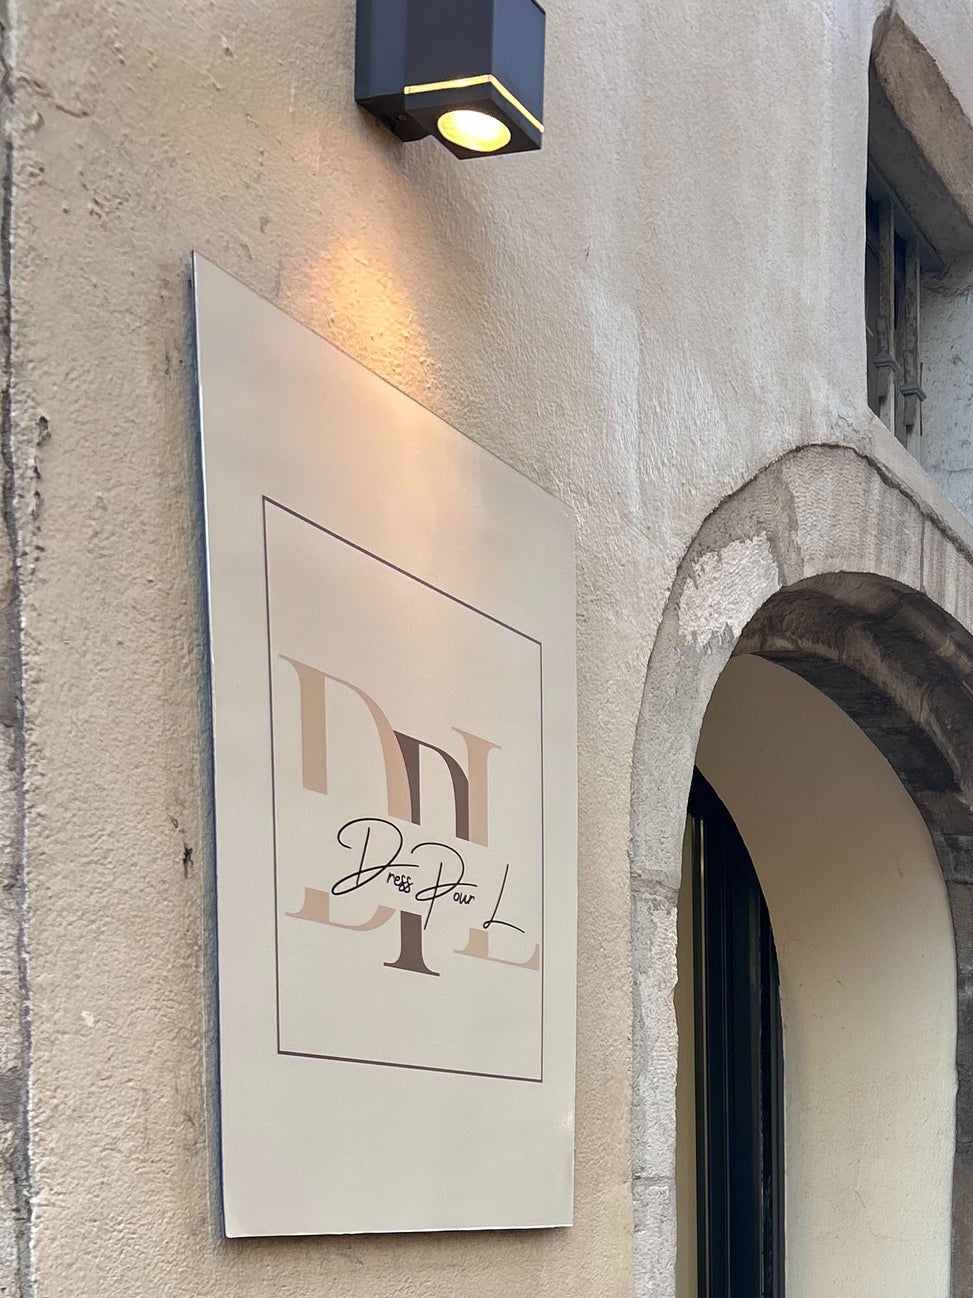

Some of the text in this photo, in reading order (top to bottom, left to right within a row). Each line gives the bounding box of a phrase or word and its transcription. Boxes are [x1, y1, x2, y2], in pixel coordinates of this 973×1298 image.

[331, 818, 525, 934] Dress Pour L
